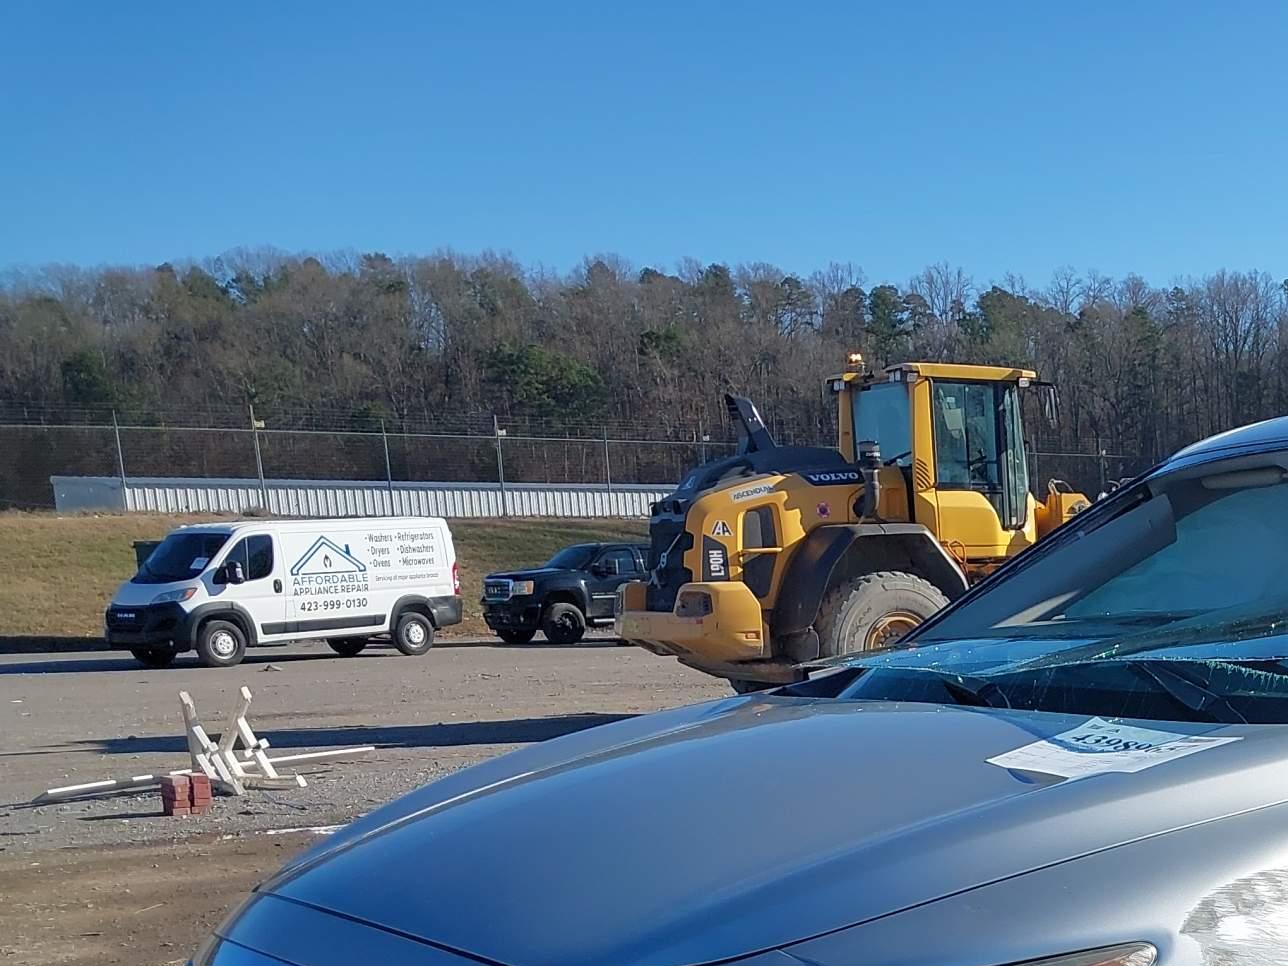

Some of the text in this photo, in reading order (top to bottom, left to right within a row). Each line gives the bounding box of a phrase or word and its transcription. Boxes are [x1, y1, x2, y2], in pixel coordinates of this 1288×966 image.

[808, 472, 859, 481] VOLVO
[368, 531, 434, 542] Washers Refrigerators
[371, 544, 434, 557] Dryers Dishwashers
[373, 556, 434, 567] Ovens Microwaves
[708, 550, 725, 576] L90H
[293, 573, 369, 586] AFFORDABLE
[294, 583, 369, 596] APPLIANCE REPAIR
[300, 597, 368, 611] 423-999-0130
